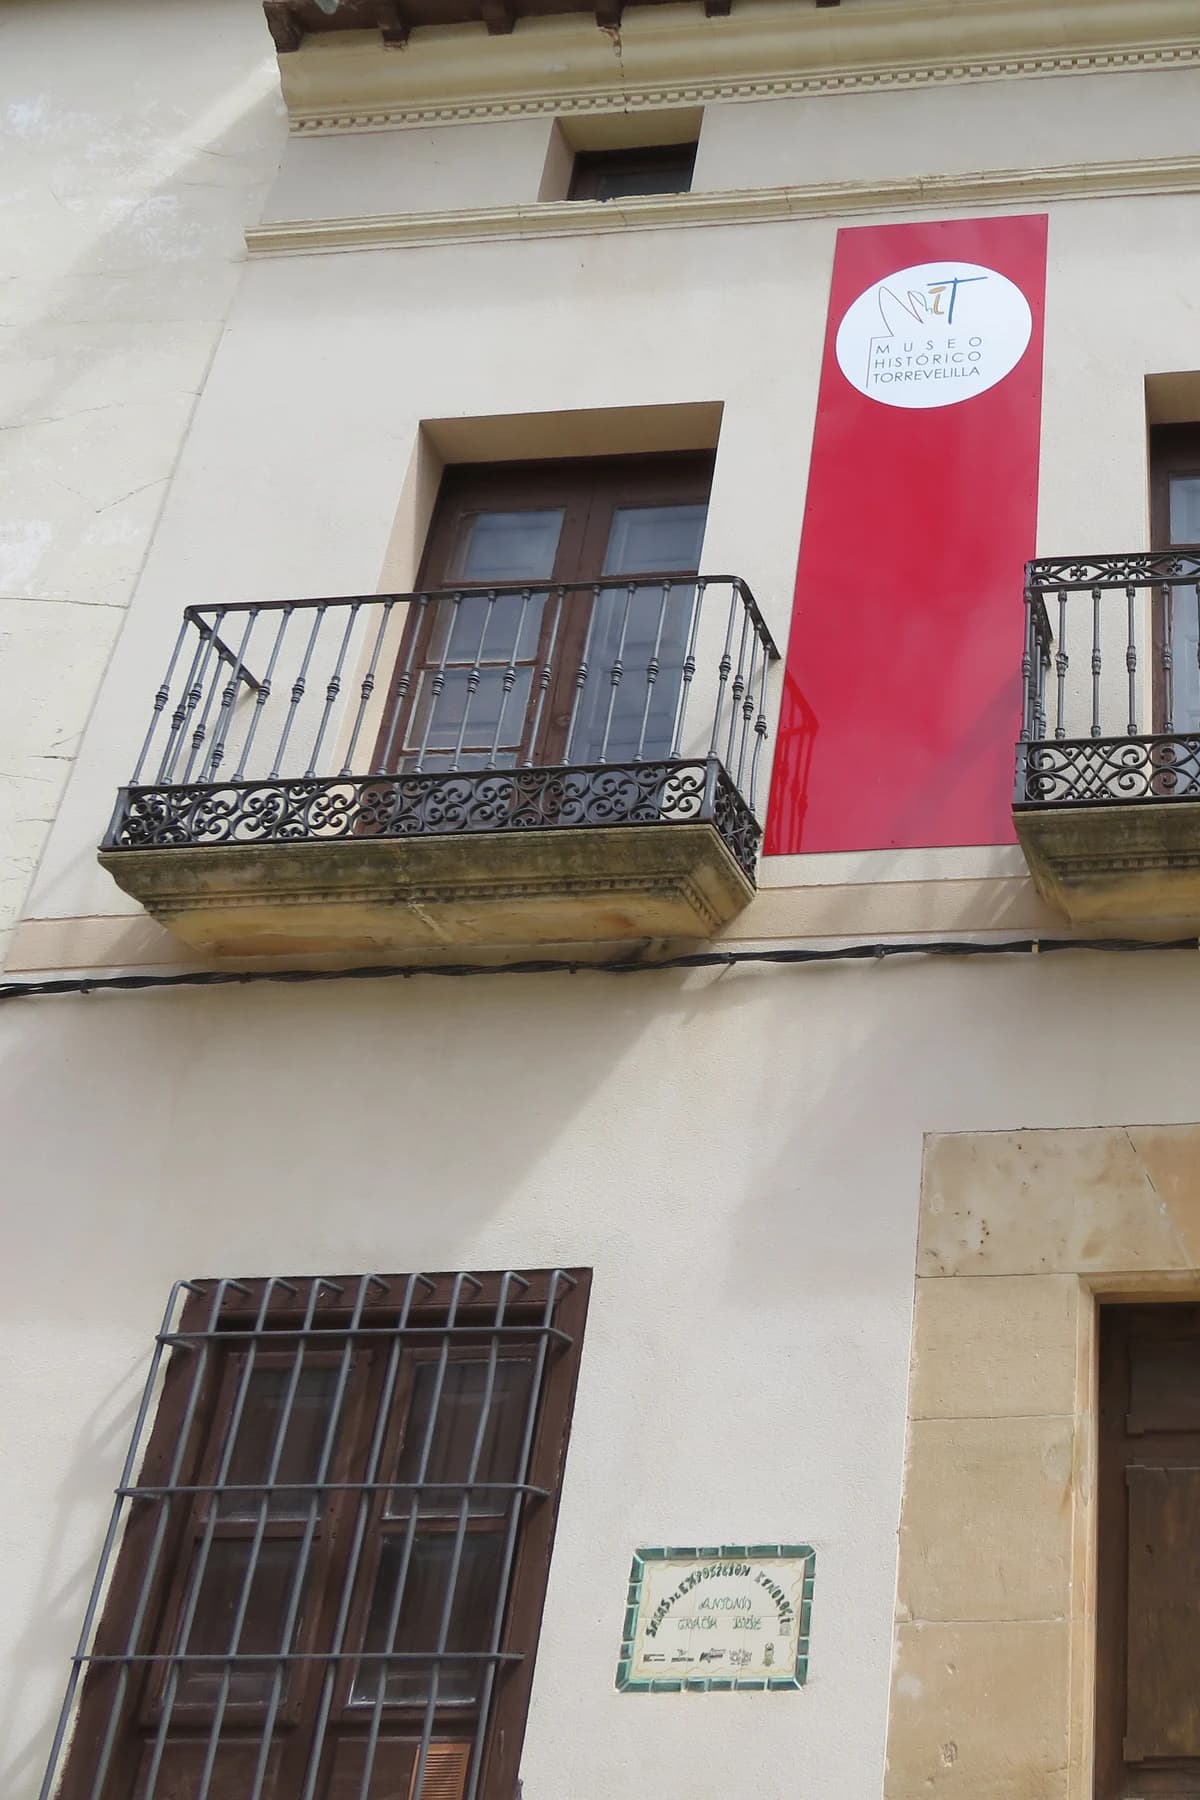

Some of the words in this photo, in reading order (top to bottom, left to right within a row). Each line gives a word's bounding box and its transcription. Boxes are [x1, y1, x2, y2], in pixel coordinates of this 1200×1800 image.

[875, 337, 983, 355] MUSEO
[874, 351, 982, 370] HISTÓRICO
[873, 366, 981, 384] TORREVELILLA
